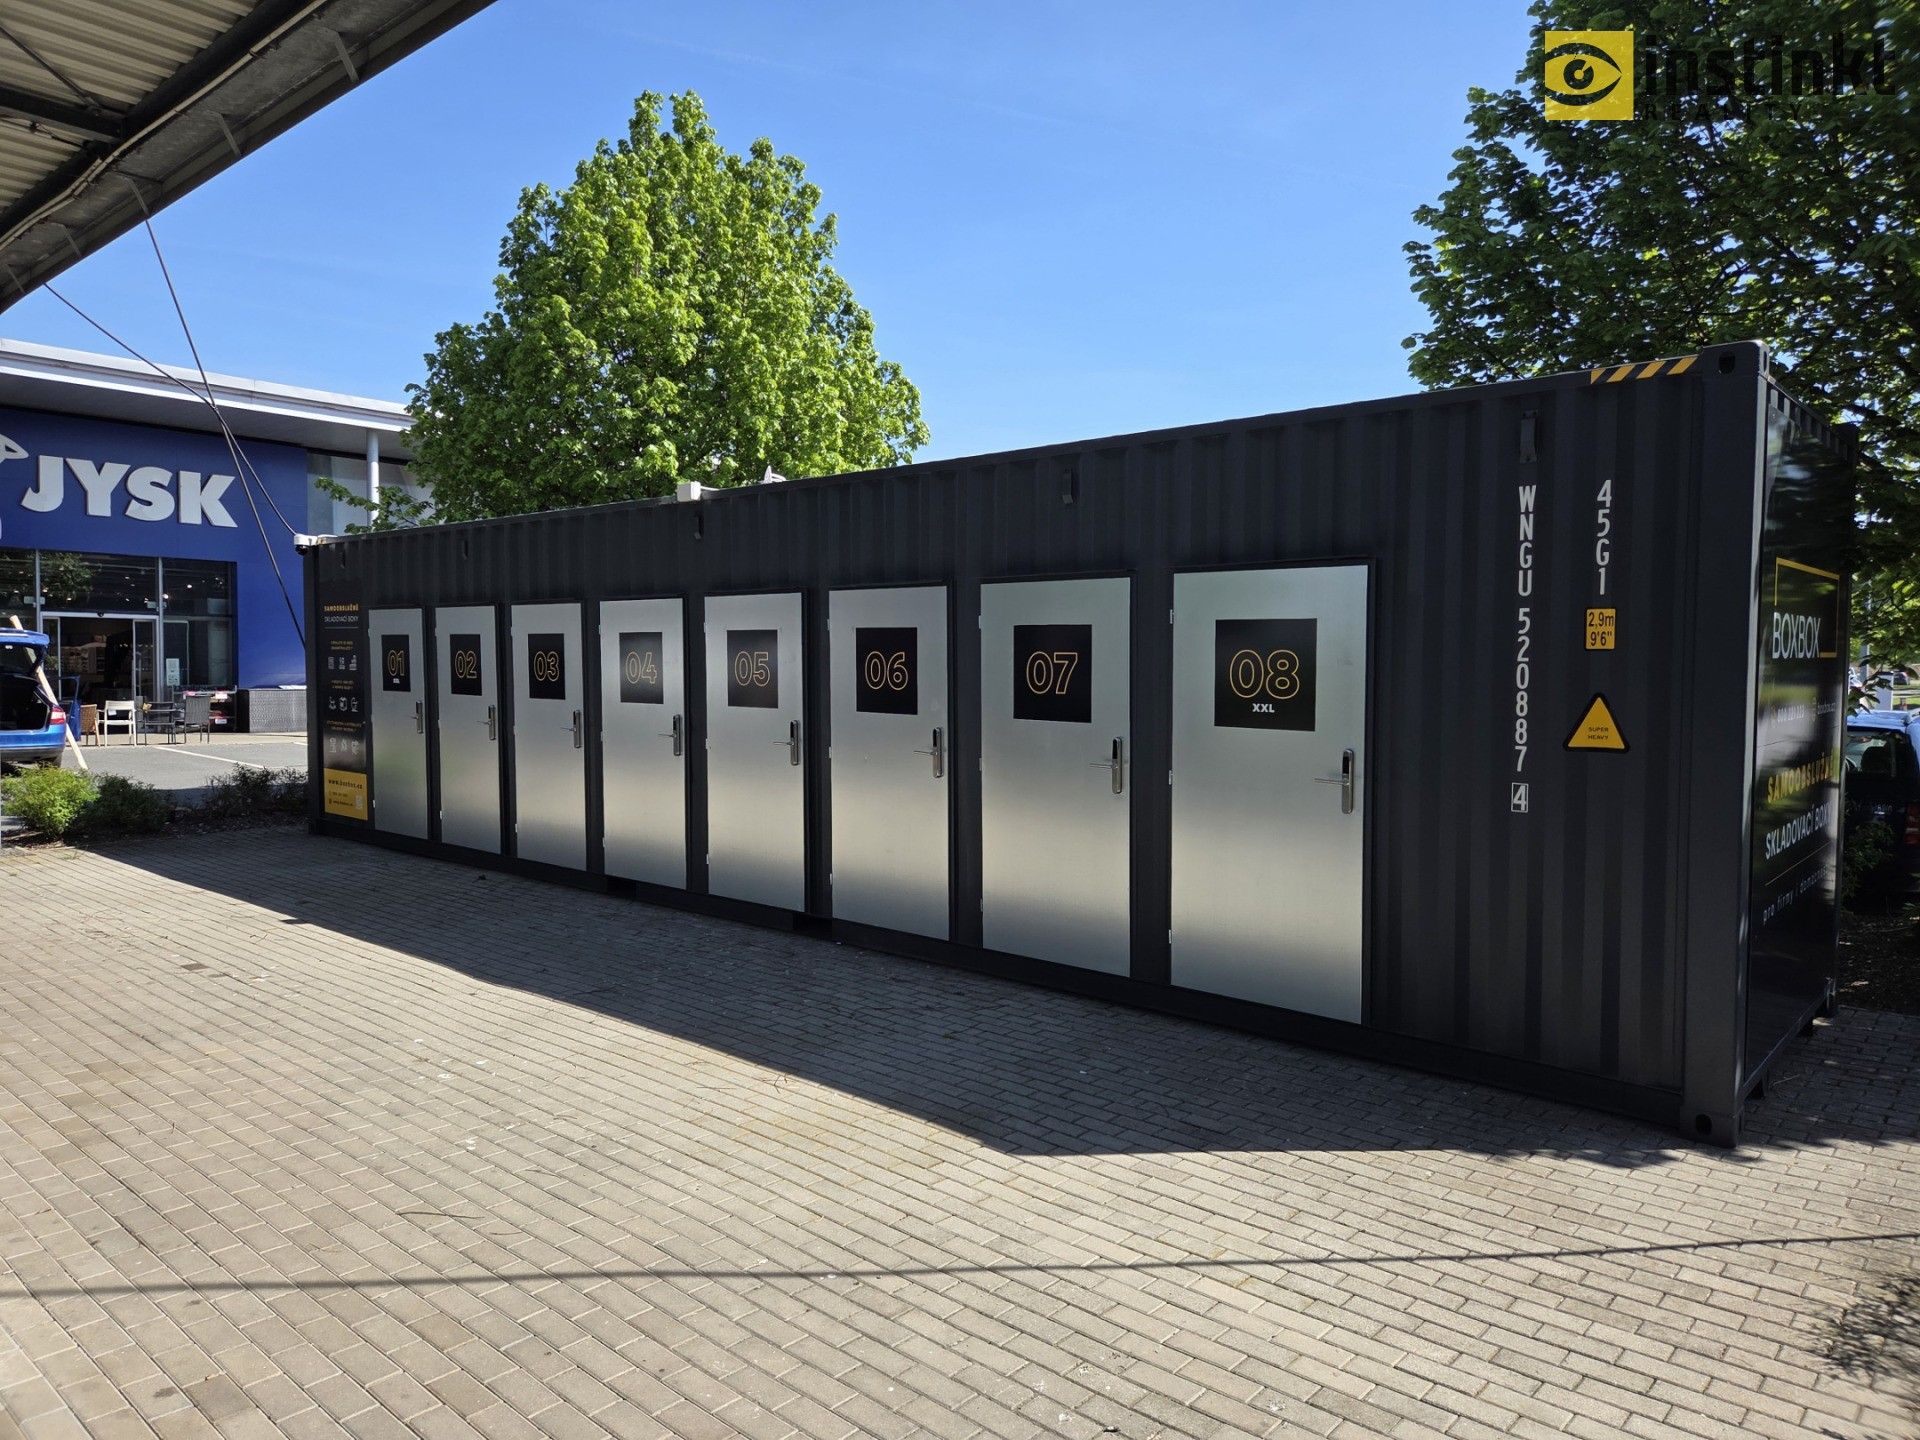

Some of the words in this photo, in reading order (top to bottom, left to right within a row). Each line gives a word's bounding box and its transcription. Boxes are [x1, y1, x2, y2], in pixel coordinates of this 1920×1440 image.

[21, 455, 238, 527] JYSK
[1518, 485, 1536, 596] WNGU
[1596, 480, 1612, 595] 45G1
[1589, 611, 1615, 628] 2,9m
[1772, 611, 1821, 659] BOXBOX
[1590, 631, 1612, 646] 9'6"
[387, 650, 404, 676] 01
[455, 650, 477, 678] 02
[534, 651, 559, 681] 03
[625, 652, 657, 684] 04
[735, 651, 770, 686] 05
[865, 651, 908, 690] 06
[1026, 651, 1078, 694] 07
[1229, 650, 1299, 699] 08
[1252, 703, 1275, 713] XXL
[1513, 608, 1530, 772] 520887
[1512, 783, 1527, 812] 4
[1765, 804, 1815, 860] SKLADOVACÍ
